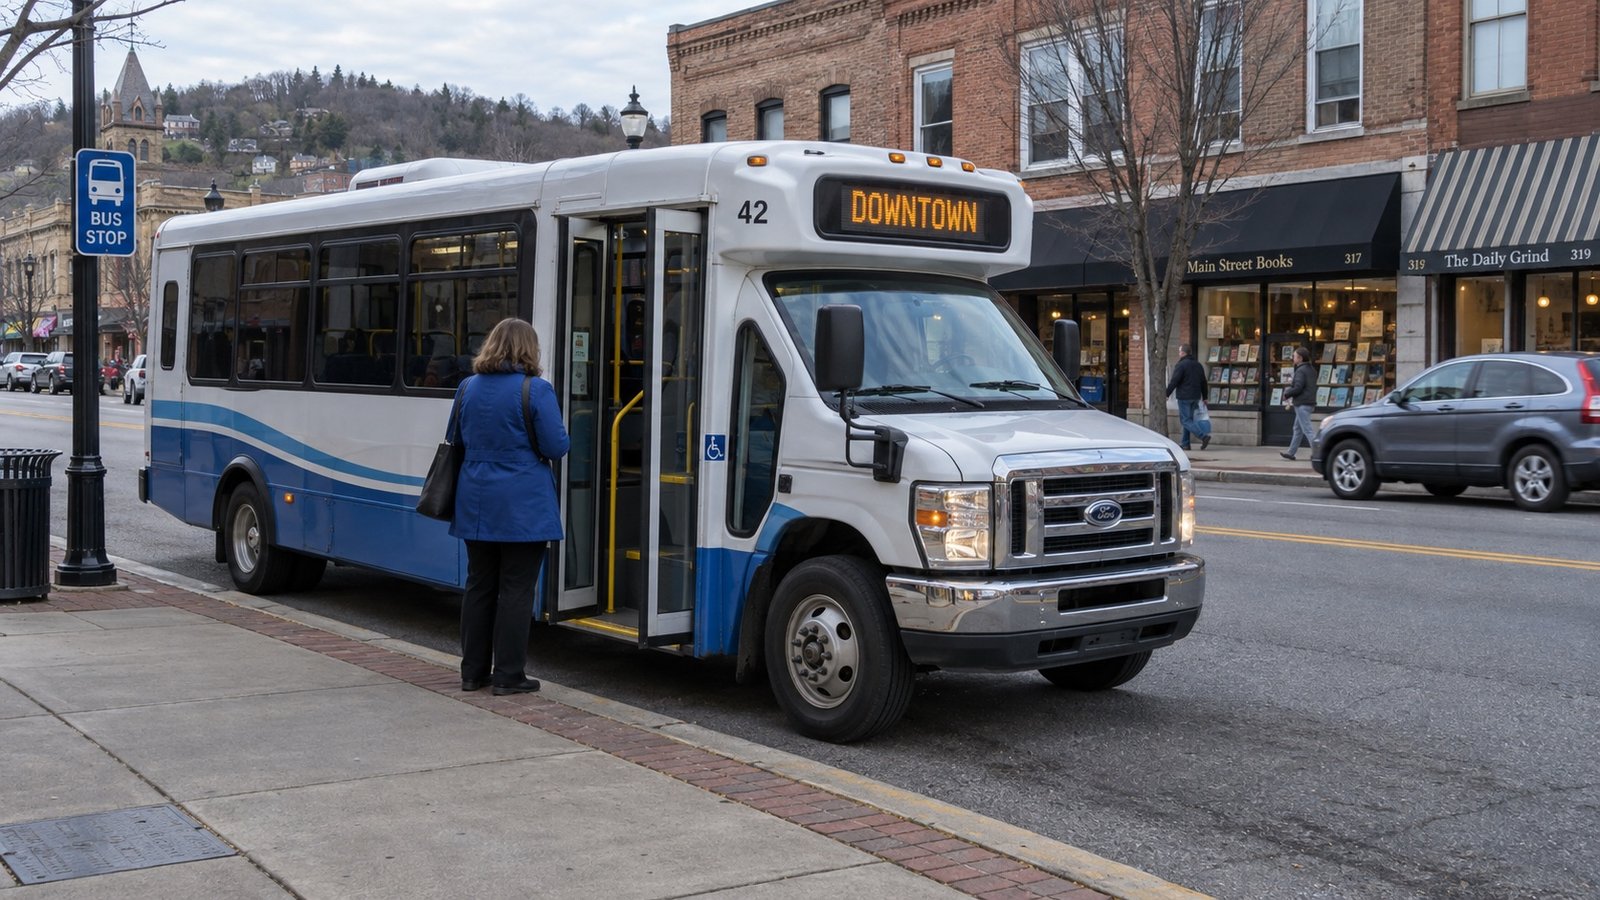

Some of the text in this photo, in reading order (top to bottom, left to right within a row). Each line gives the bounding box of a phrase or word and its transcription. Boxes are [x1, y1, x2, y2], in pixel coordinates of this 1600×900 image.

[91, 211, 122, 226] BUS
[738, 200, 768, 224] 42
[852, 189, 977, 233] DOWNTOWN
[86, 229, 127, 245] STOP
[1344, 252, 1362, 265] 317
[1444, 248, 1550, 268] The Daily Grind
[1571, 248, 1592, 261] 319
[1187, 254, 1293, 274] Main Street Books
[1408, 259, 1425, 270] 319
